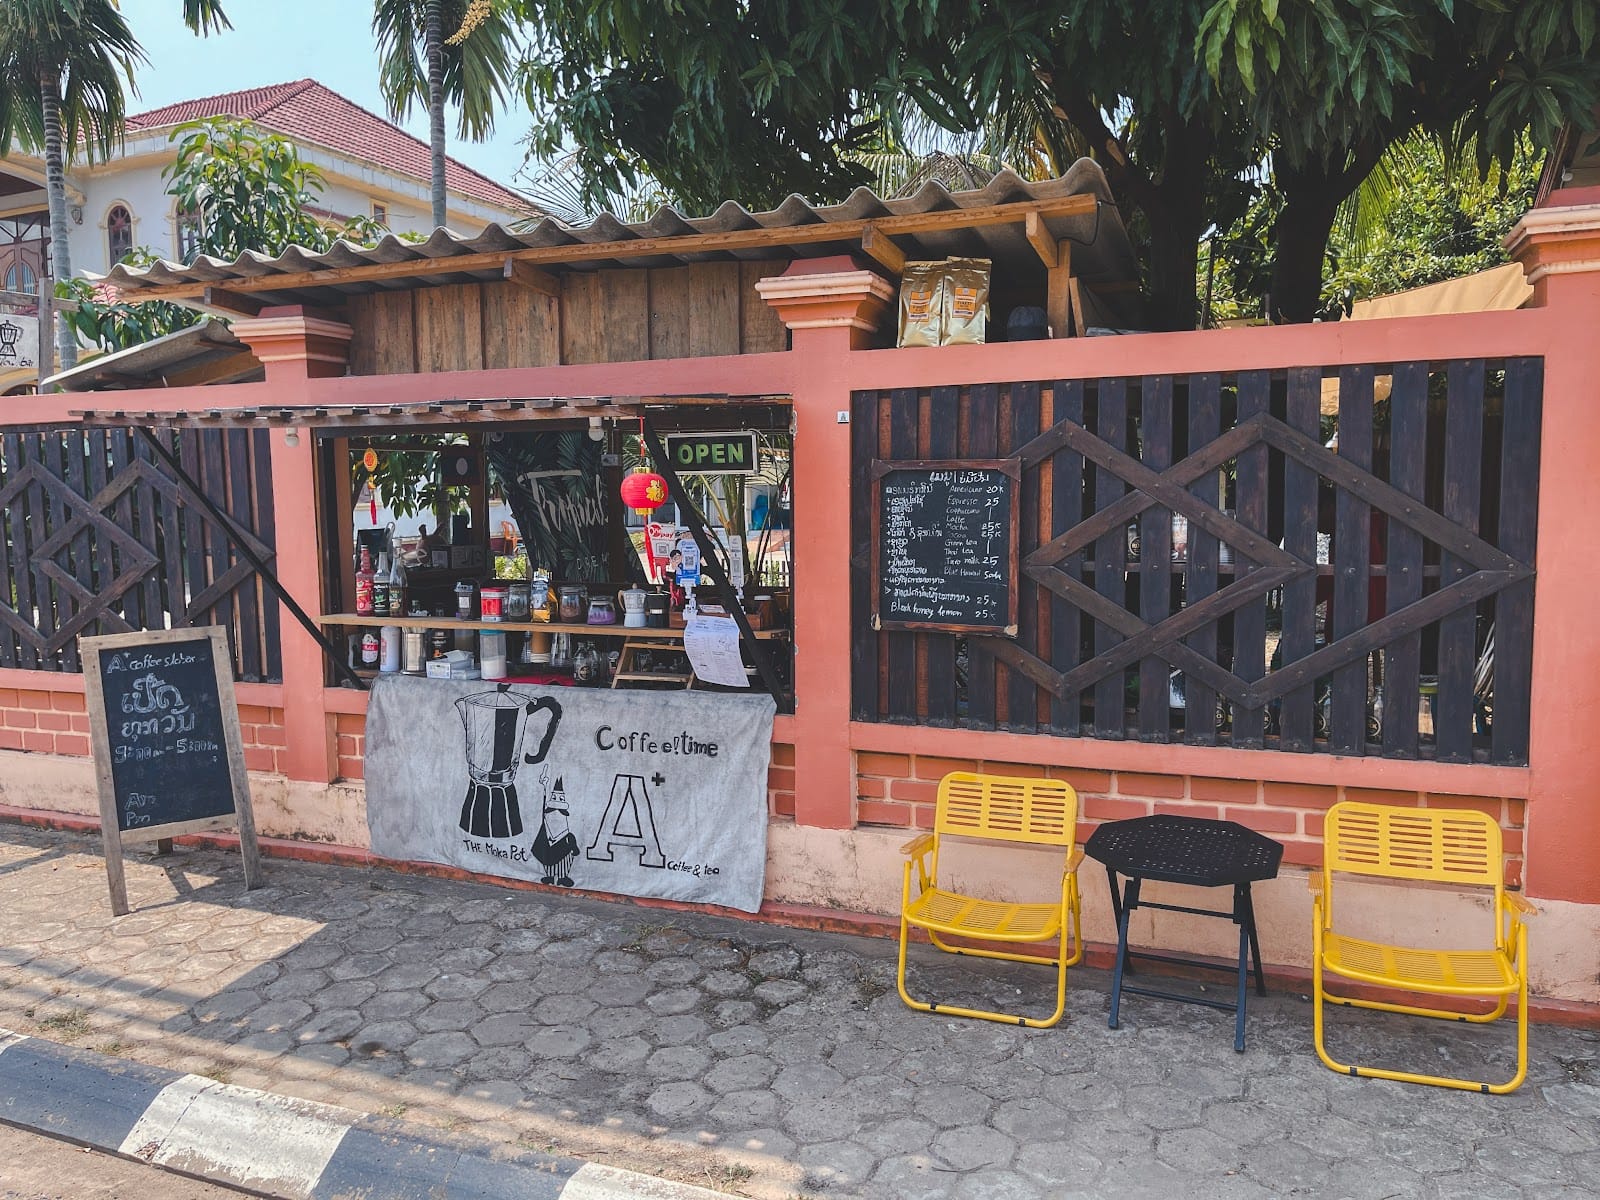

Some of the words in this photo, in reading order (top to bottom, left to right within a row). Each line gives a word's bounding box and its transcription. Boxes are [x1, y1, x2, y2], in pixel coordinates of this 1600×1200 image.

[677, 443, 744, 465] OPEN
[485, 841, 509, 859] Moka
[510, 844, 528, 862] Pot
[704, 863, 720, 875] tea
